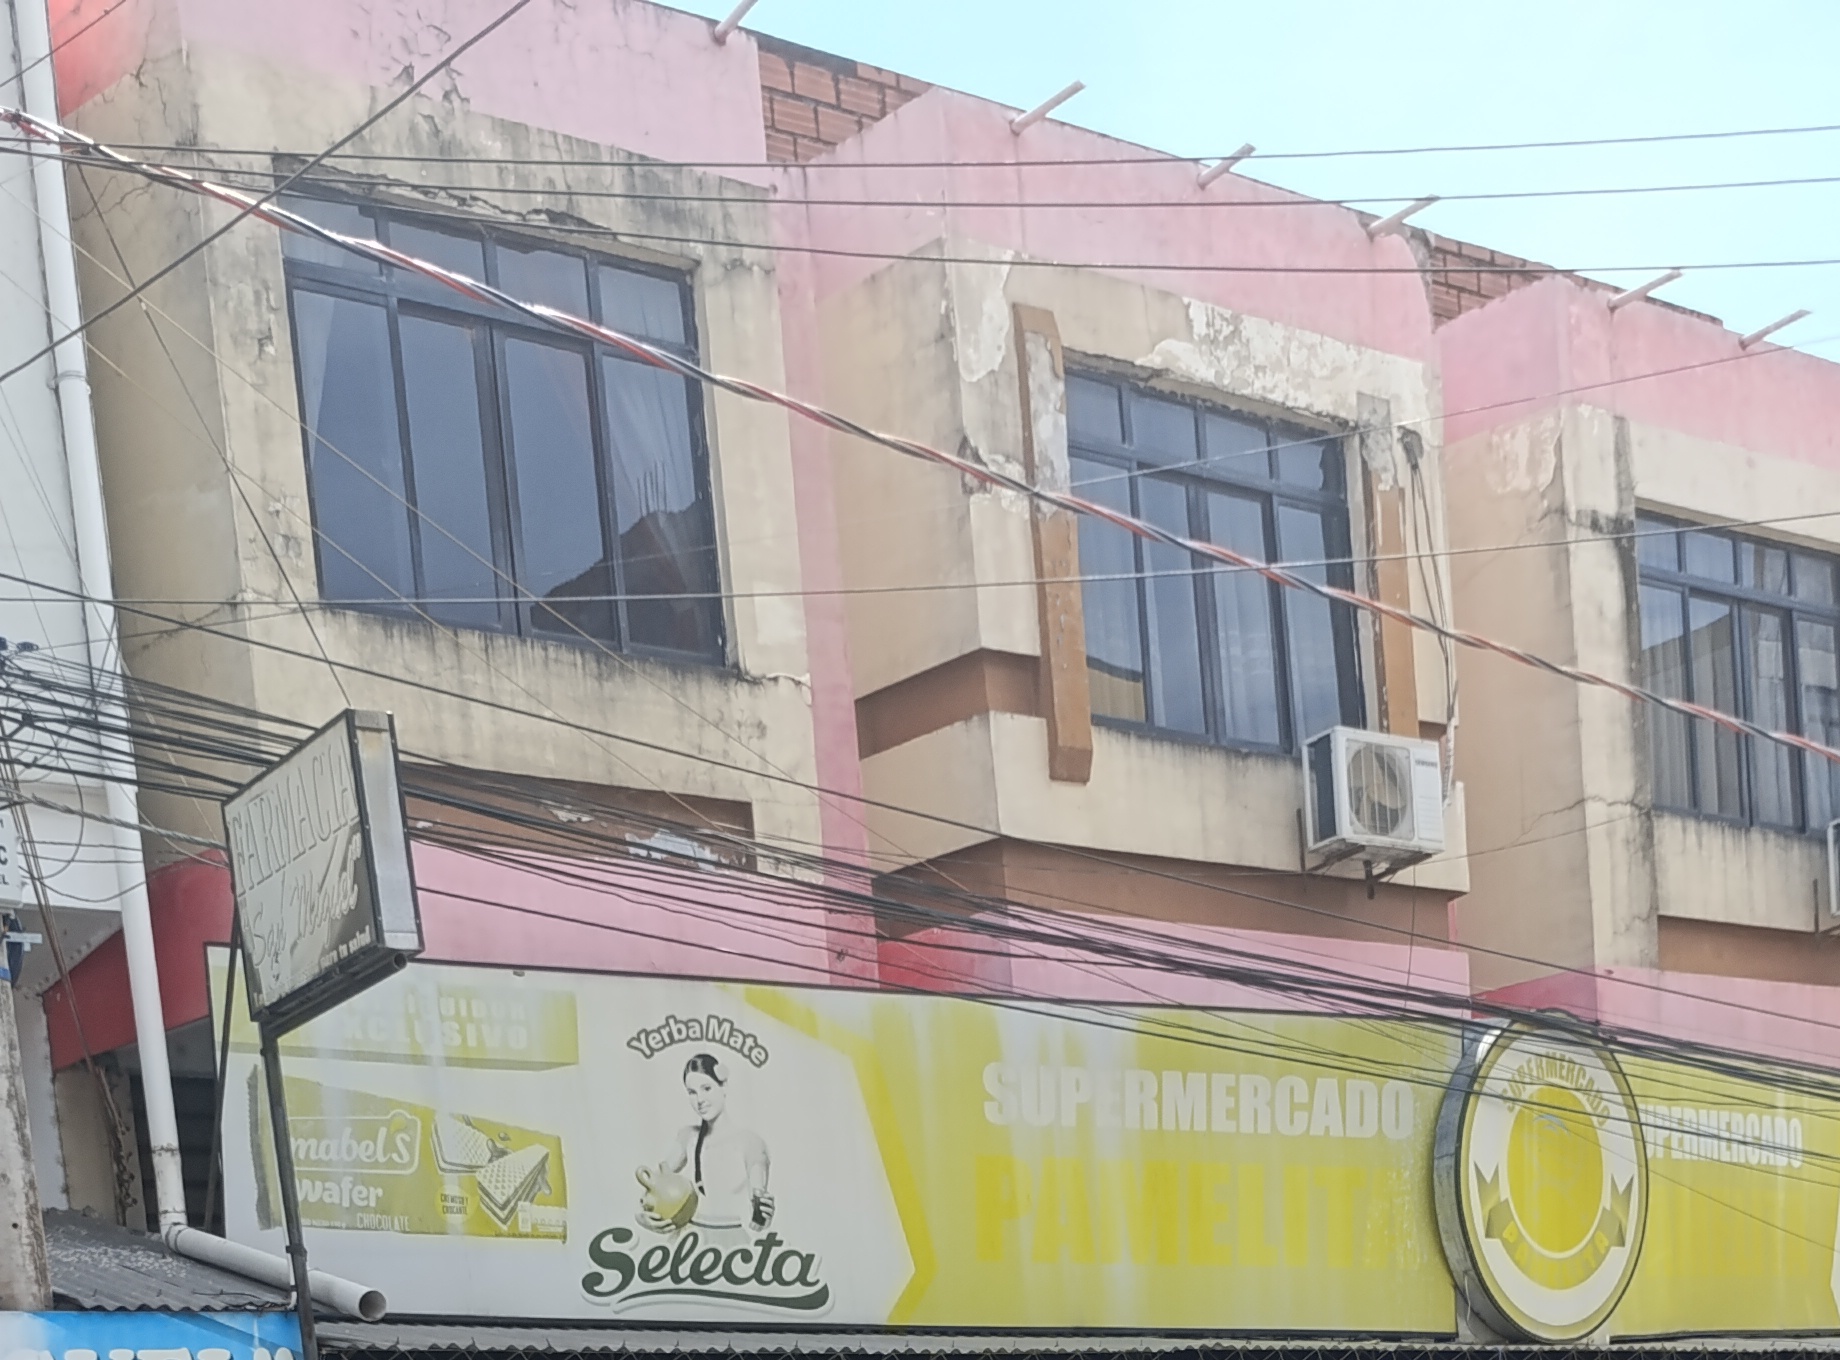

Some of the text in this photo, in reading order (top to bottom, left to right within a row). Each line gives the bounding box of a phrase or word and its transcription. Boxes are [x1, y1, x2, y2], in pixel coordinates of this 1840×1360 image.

[229, 736, 359, 897] FARMACIA
[343, 1014, 528, 1050] XCLUSIVO
[627, 1015, 769, 1068] Yerba Mate
[982, 1060, 1415, 1140] SUPERMERCADO
[1502, 1052, 1611, 1128] SUPERMERCADO
[1641, 1102, 1803, 1168] UPERMERCADO
[296, 1178, 384, 1207] wafer
[356, 1212, 410, 1232] CHOCOLATE
[975, 1155, 1419, 1270] PAMELITA
[582, 1227, 822, 1300] Selecta
